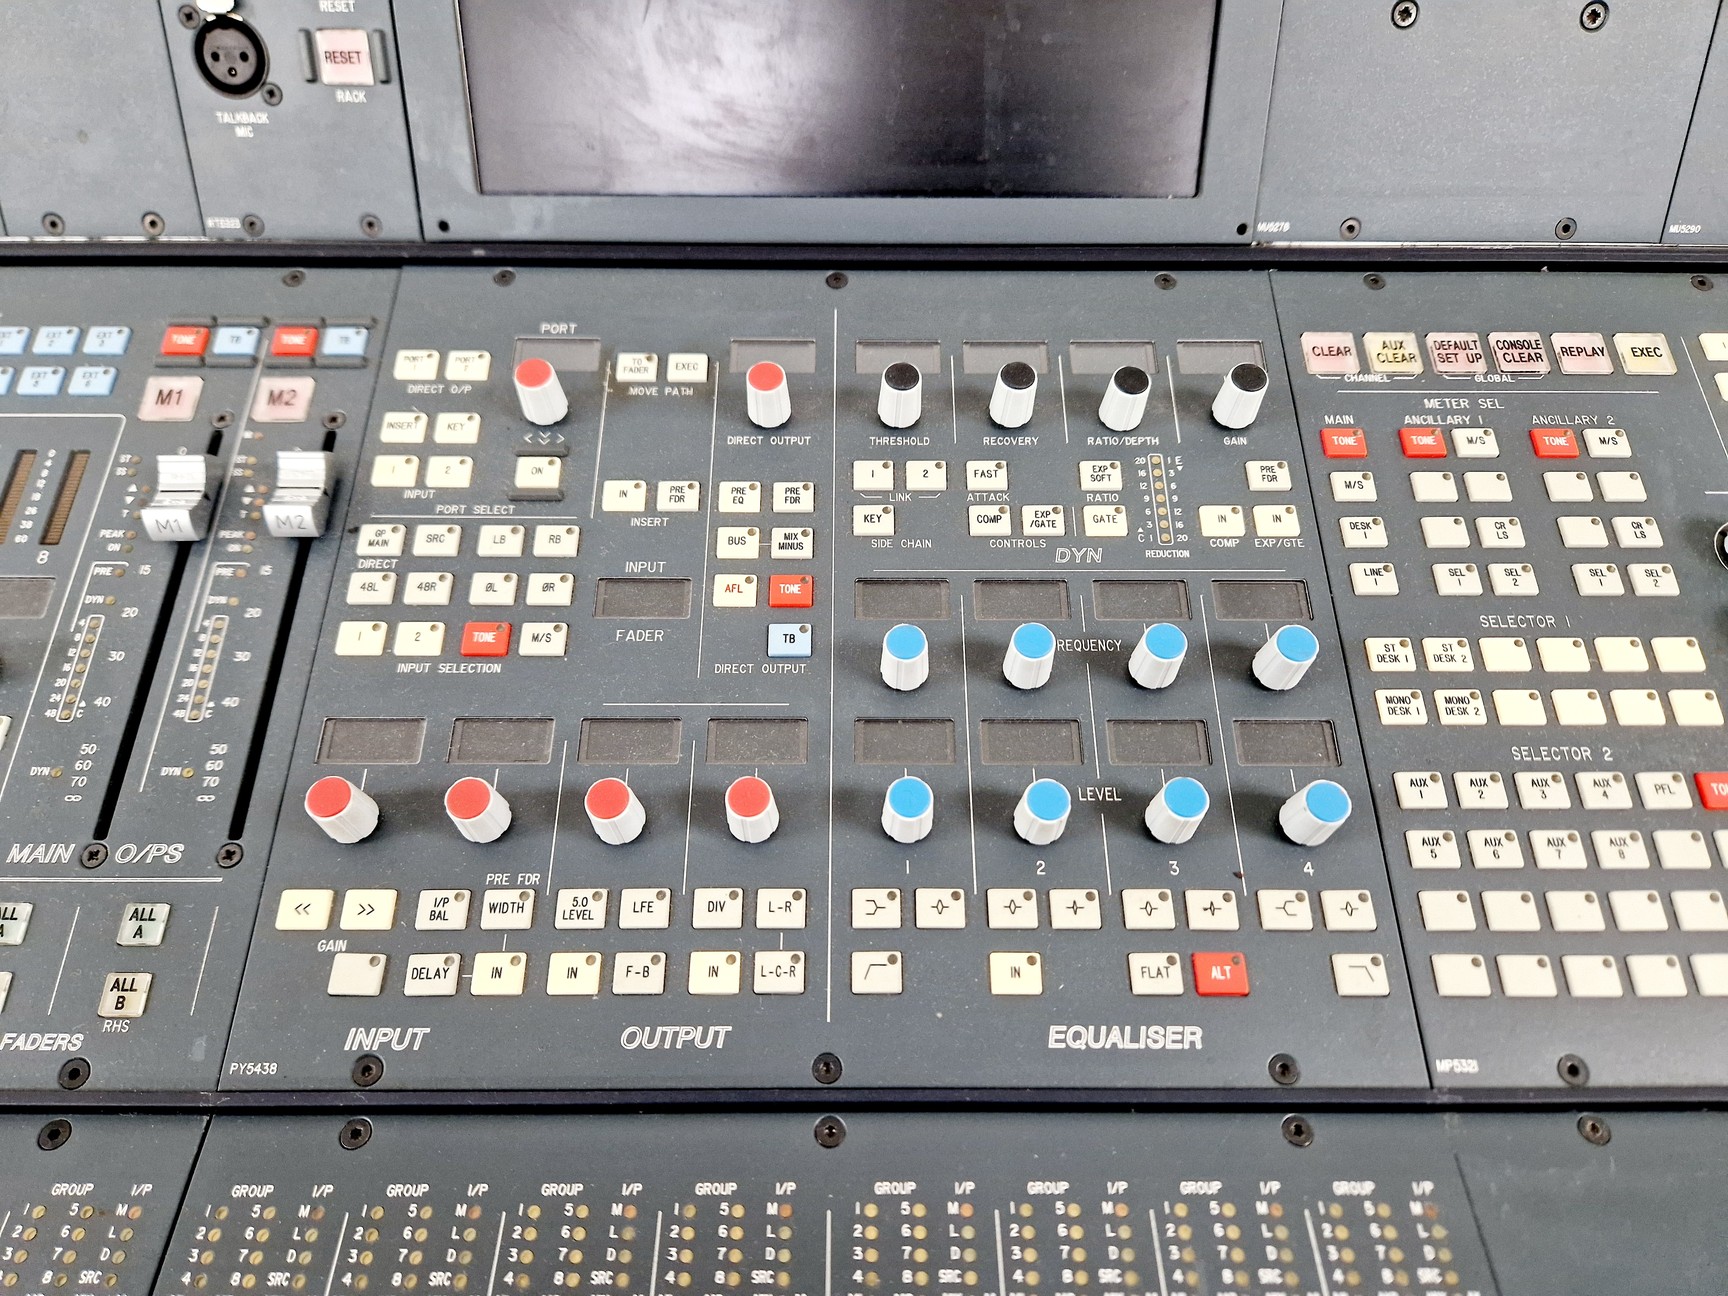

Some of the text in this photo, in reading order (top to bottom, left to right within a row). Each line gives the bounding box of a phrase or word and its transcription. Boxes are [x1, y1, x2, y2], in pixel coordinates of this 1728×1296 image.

[320, 0, 355, 12] RESET
[325, 51, 362, 65] RESET
[336, 90, 367, 103] RACK
[235, 126, 254, 138] MIC
[541, 323, 577, 334] PORT
[172, 335, 195, 345] TONE
[1496, 339, 1543, 351] CONSOLE
[1382, 340, 1405, 351] AUX
[1434, 340, 1479, 351] DEFAULT
[1312, 346, 1352, 358] CLEAR
[1561, 346, 1606, 358] REPLAY
[1631, 346, 1663, 358] EXEC
[1377, 352, 1417, 364] CLEAR
[1438, 353, 1482, 364] SET UP
[1503, 352, 1544, 364] CLEAR
[1344, 374, 1391, 383] CHANNEL
[1474, 374, 1516, 383] GLOBAL
[408, 385, 472, 394] DIRECT O/P
[629, 387, 693, 396] MOVE PATH
[155, 390, 183, 405] M1
[267, 390, 297, 406] M2
[1424, 399, 1505, 409] METER SEL
[1324, 415, 1354, 424] MAIN
[1404, 415, 1470, 425] ANCILLARY
[1532, 415, 1615, 425] ANCILLARY 2
[727, 436, 811, 445] DIRECT OUTPUT
[870, 437, 930, 446] THRESHOLD
[983, 437, 1039, 446] RECOVERY
[1087, 437, 1159, 446] RATIO/DEPTH
[1224, 437, 1247, 446] GAIN
[1332, 436, 1357, 445] TONE
[1411, 436, 1437, 445] TONE
[1544, 437, 1568, 446] TONE
[1599, 437, 1618, 445] M/S
[974, 469, 998, 478] FAST
[1090, 474, 1112, 482] SOFT
[404, 490, 435, 499] INPUT
[889, 493, 912, 501] LINK
[967, 493, 1009, 501] ATTACK
[1086, 494, 1119, 502] RATIO
[436, 506, 516, 515] PORT SELECT
[275, 515, 307, 530] M2
[631, 518, 669, 527] INSERT
[864, 515, 882, 524] KEY
[977, 515, 1002, 524] COMP
[1030, 520, 1057, 528] /GATE
[1093, 515, 1118, 524] GATE
[156, 518, 182, 533] M1
[1350, 522, 1372, 530] DESK
[100, 530, 125, 538] PEAK
[426, 534, 445, 543] SRC
[368, 539, 389, 547] MAIN
[727, 536, 746, 546] BUS
[779, 542, 804, 550] MINUS
[871, 539, 932, 548] SIDE CHAIN
[990, 539, 1046, 548] CONTROLS
[1210, 539, 1239, 548] COMP
[1255, 539, 1304, 548] EXP/GTE
[37, 550, 49, 564] 8
[1056, 548, 1102, 563] DYN
[1146, 550, 1190, 558] REDUCTION
[358, 560, 398, 568] DIRECT
[625, 562, 666, 573] INPUT
[94, 567, 113, 576] PRE
[1364, 568, 1384, 576] LINE
[1449, 569, 1465, 577] SEL
[1504, 568, 1521, 577] SEL
[1589, 569, 1606, 577] SEL
[1645, 569, 1662, 577] SEL
[360, 582, 379, 591] 48L
[417, 582, 436, 591] 48R
[725, 584, 743, 593] AFL
[780, 584, 801, 594] TONE
[85, 595, 104, 604] DYN
[121, 607, 138, 617] 20
[1480, 615, 1556, 628] SELECTOR
[473, 632, 496, 642] TONE
[615, 630, 664, 642] FADER
[783, 634, 796, 644] TB
[1057, 639, 1121, 652] REQUENCY
[108, 651, 125, 661] 30
[397, 664, 502, 673] INPUT SELECTION
[714, 664, 807, 674] DIRECT OUTPUT
[94, 697, 111, 707] 40
[221, 698, 240, 707] 40
[1386, 696, 1411, 704] MONO
[1444, 696, 1470, 704] MONO
[80, 744, 97, 754] 50
[209, 744, 228, 755] 50
[1512, 747, 1613, 761] SELECTOR 2
[75, 761, 92, 771] 60
[205, 761, 224, 771] 60
[30, 767, 50, 776] DYN
[161, 767, 182, 776] DYN
[71, 777, 87, 787] 70
[202, 777, 219, 787] 70
[1410, 778, 1428, 787] AUX
[1470, 778, 1489, 787] AUX
[1531, 778, 1550, 788] AUX
[1593, 778, 1612, 788] AUX
[1078, 787, 1122, 802] LEVEL
[1422, 837, 1441, 847] AUX
[1484, 837, 1503, 847] AUX
[1547, 837, 1566, 847] AUX
[6, 844, 75, 863] MAIN
[114, 844, 184, 864] O/PS
[1036, 861, 1046, 875] 2
[1170, 860, 1180, 876] 3
[1304, 862, 1314, 876] 4
[486, 874, 540, 885] PRE FDR
[572, 897, 588, 908] 5.0
[633, 901, 654, 913] LFE
[708, 901, 725, 912] DIV
[769, 902, 792, 912] L-R
[488, 902, 525, 914] WIDTH
[129, 907, 156, 921] ALL
[429, 910, 449, 921] BAL
[562, 910, 594, 920] LEVEL
[318, 940, 347, 951] GAIN
[411, 968, 449, 980] DELAY
[626, 966, 650, 977] F-B
[761, 967, 796, 977] L-C-R
[1142, 966, 1170, 979] FLAT
[1212, 966, 1232, 980] ALT
[110, 978, 137, 992] ALL
[115, 996, 125, 1010] B
[102, 1020, 130, 1033] RHS
[0, 1033, 84, 1051] FADERS
[344, 1028, 430, 1051] INPUT
[620, 1026, 732, 1049] OUTPUT
[1048, 1026, 1203, 1050] EQUALISER
[230, 1062, 277, 1075] PY5438
[51, 1183, 94, 1196] GROUP
[131, 1184, 152, 1196] I/P
[232, 1185, 275, 1198] GROUP
[387, 1183, 430, 1198] GROUP
[541, 1183, 584, 1196] GROUP
[695, 1182, 737, 1196] GROUP
[874, 1181, 917, 1195] GROUP
[79, 1271, 102, 1284] SRC
[267, 1273, 290, 1287] SRC
[429, 1273, 451, 1287] SRC
